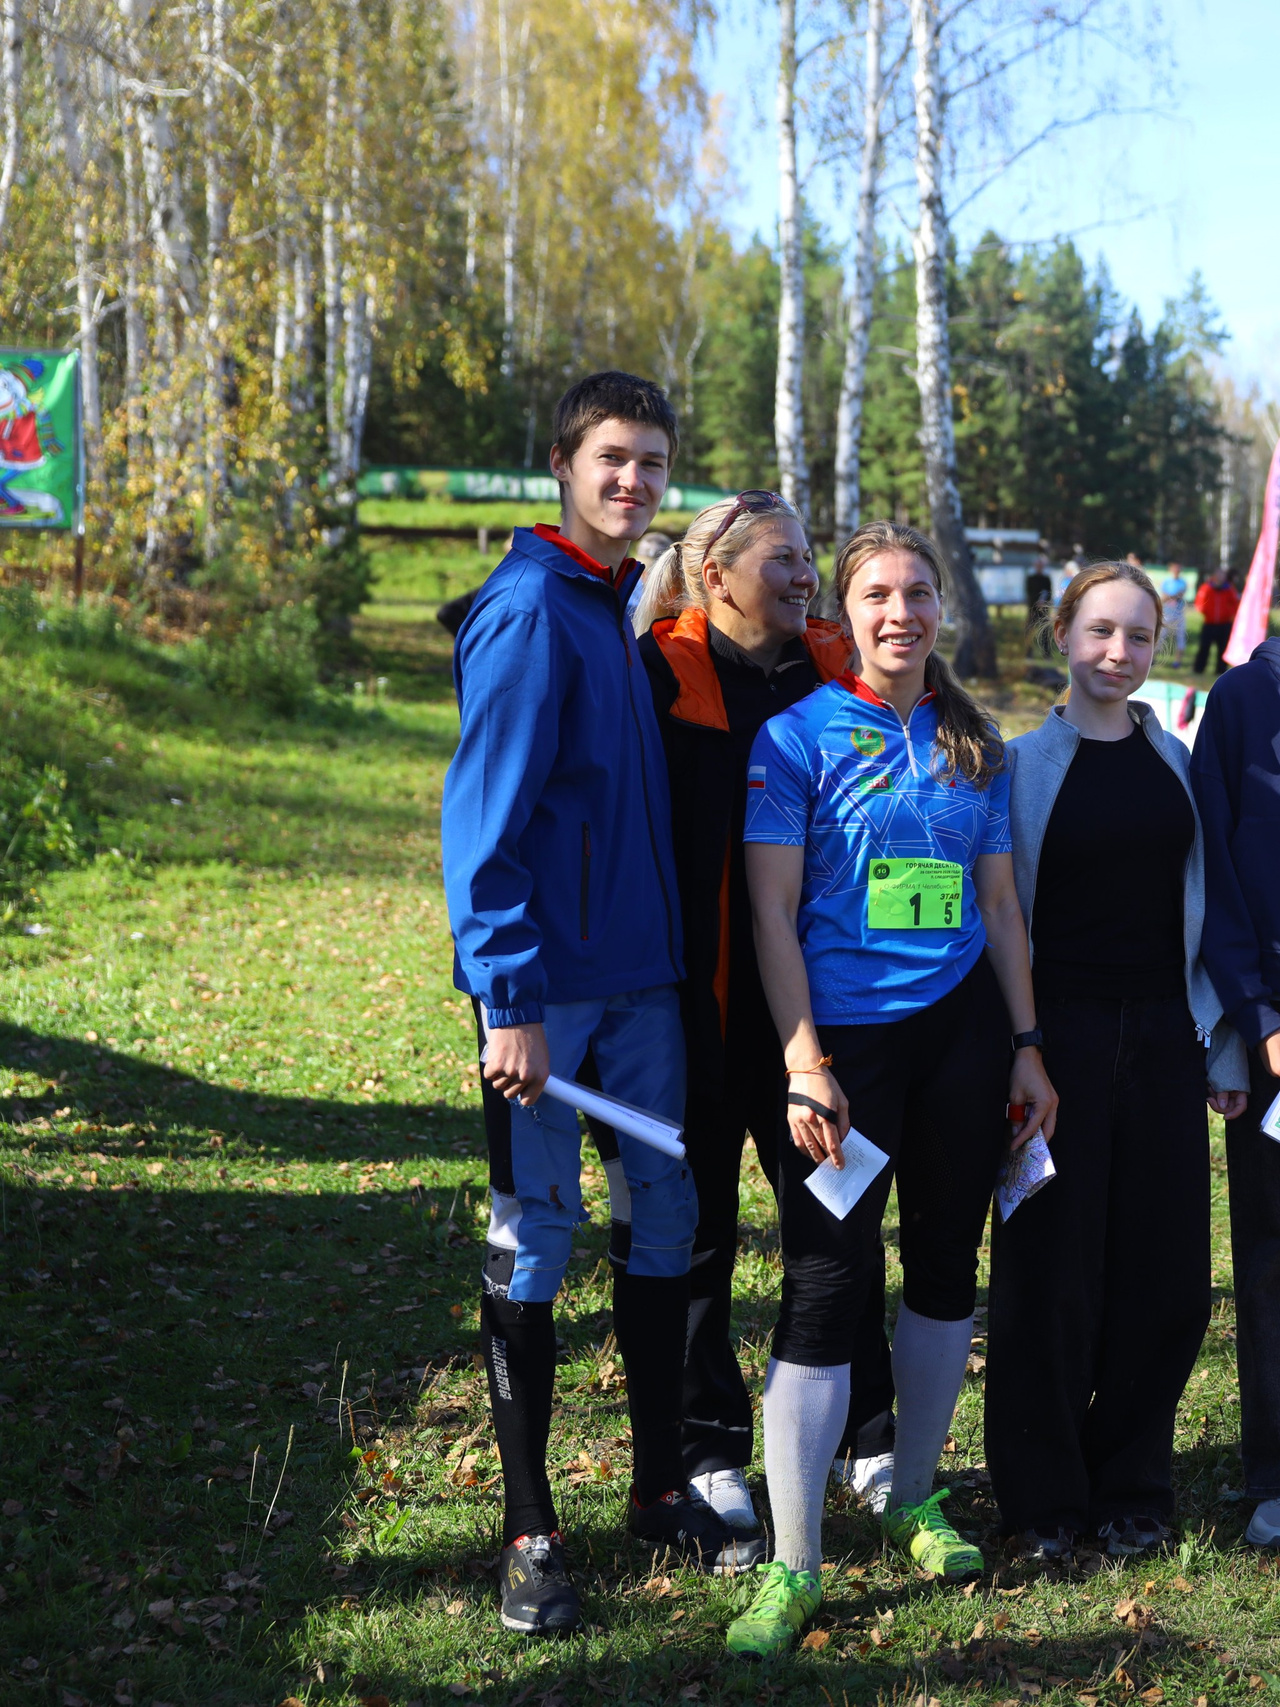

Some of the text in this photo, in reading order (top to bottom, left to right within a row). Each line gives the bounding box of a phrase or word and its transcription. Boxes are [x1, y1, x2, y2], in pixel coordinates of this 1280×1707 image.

[865, 776, 888, 788] SFR
[909, 892, 921, 926] 1
[944, 902, 953, 925] 5
